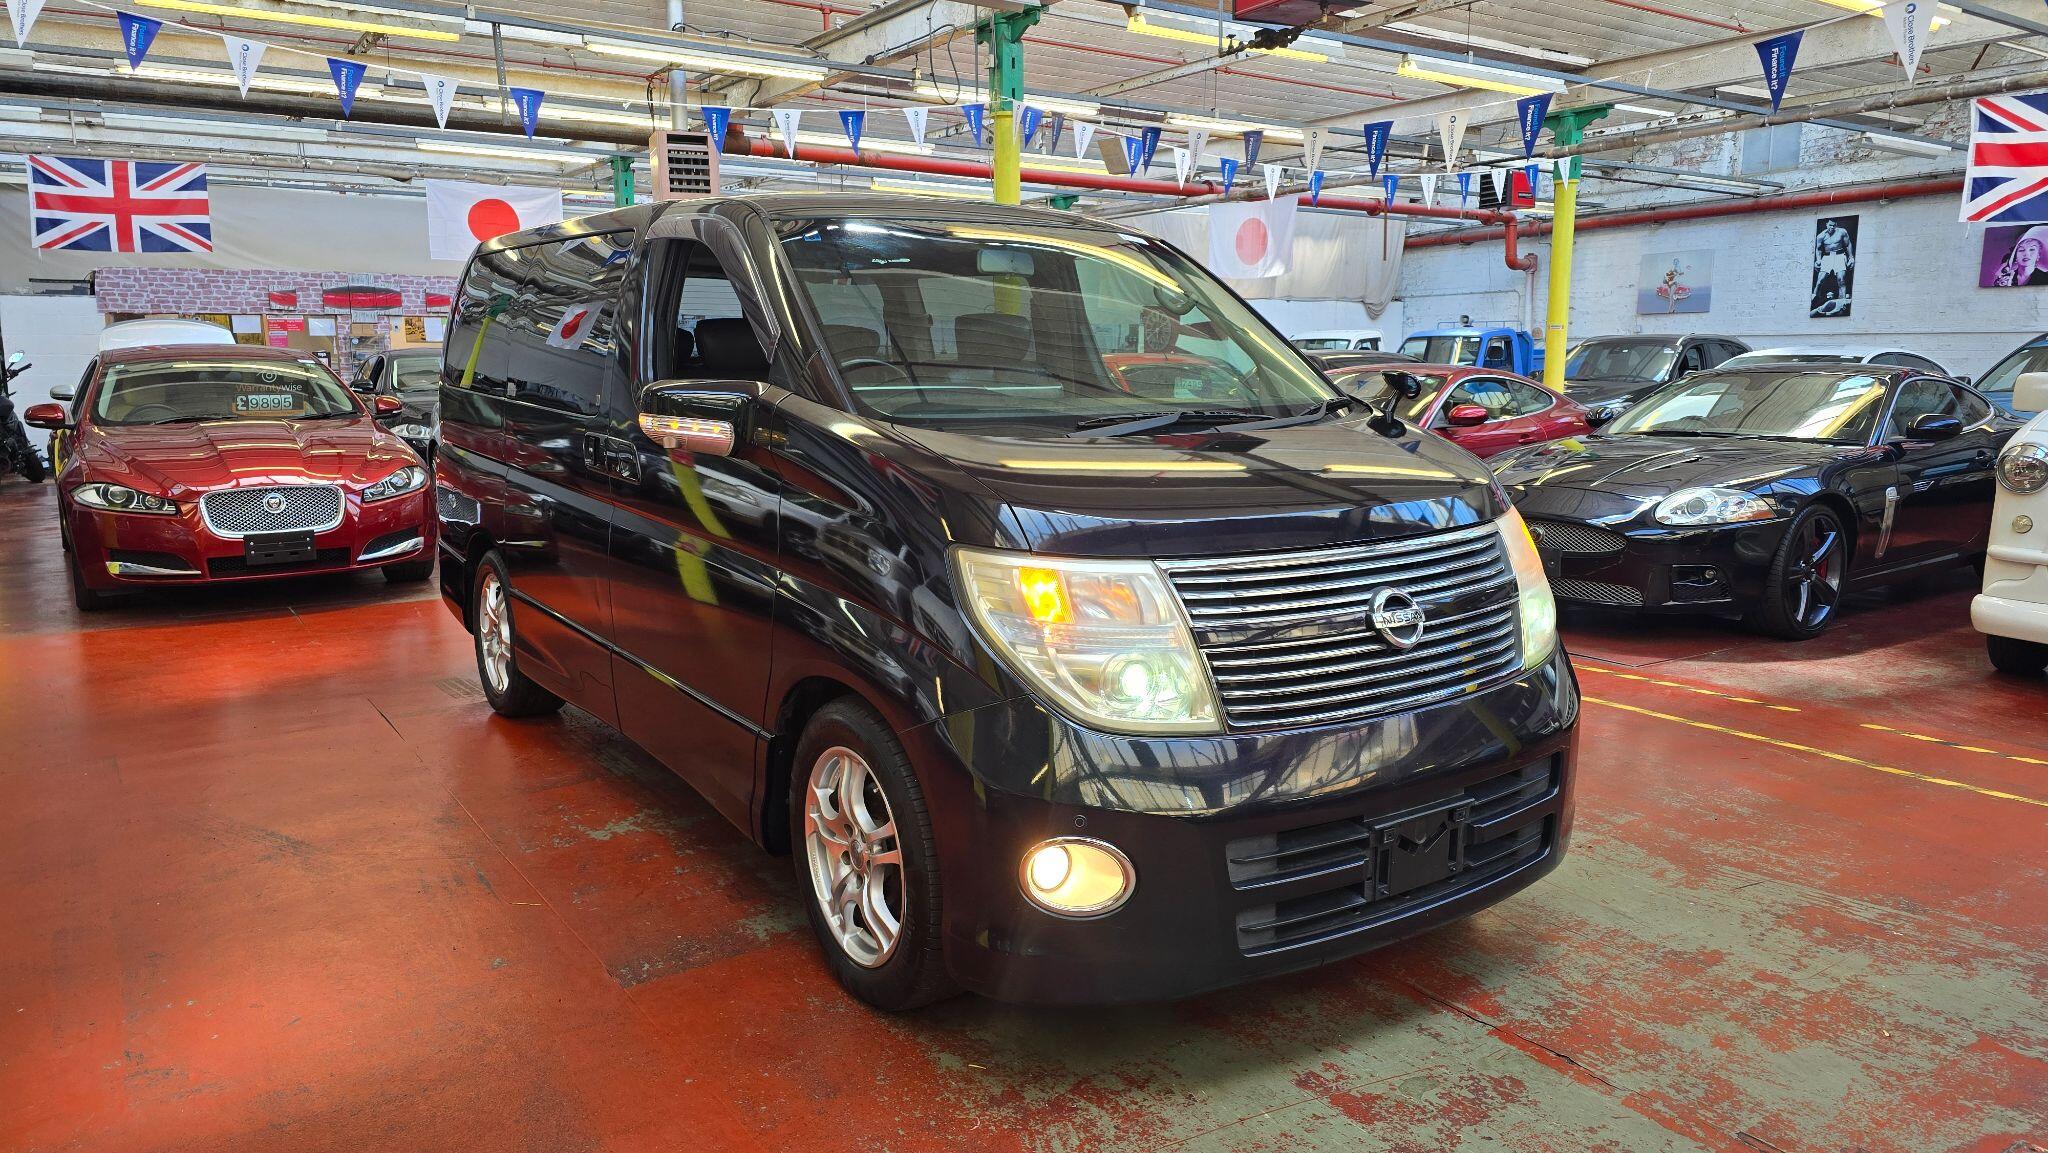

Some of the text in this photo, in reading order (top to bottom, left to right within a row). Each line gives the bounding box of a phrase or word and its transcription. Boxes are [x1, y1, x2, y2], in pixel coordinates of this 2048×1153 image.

[1771, 47, 1779, 79] Finance
[1908, 35, 1916, 65] Brothers
[1525, 104, 1535, 131] Finance
[236, 395, 293, 411] £9895
[1380, 610, 1423, 625] NISSAN
